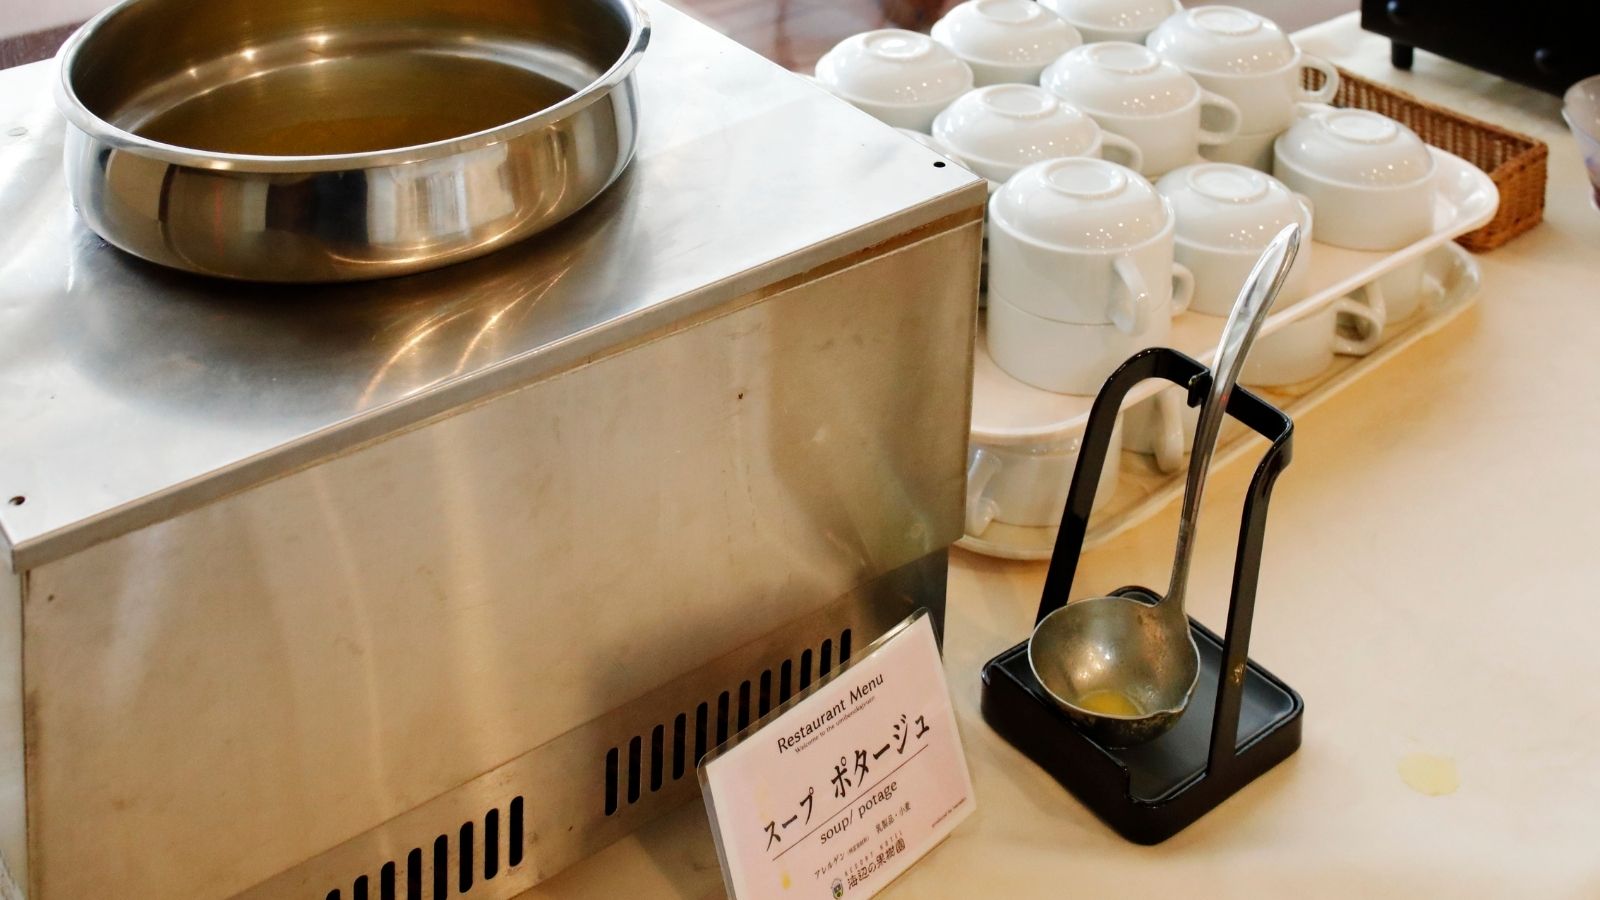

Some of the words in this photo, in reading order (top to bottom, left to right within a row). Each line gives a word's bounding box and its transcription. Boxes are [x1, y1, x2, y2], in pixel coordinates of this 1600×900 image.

[777, 699, 846, 754] Restaurant
[849, 673, 884, 704] Menu
[795, 735, 819, 753] Welcome
[826, 724, 835, 732] the
[764, 786, 814, 852] スープ
[831, 713, 930, 798] ポタージュ
[820, 808, 853, 845] soup/
[858, 781, 898, 818] potage
[814, 852, 845, 879] アレルゲン
[847, 837, 906, 890] 海辺の果樹園
